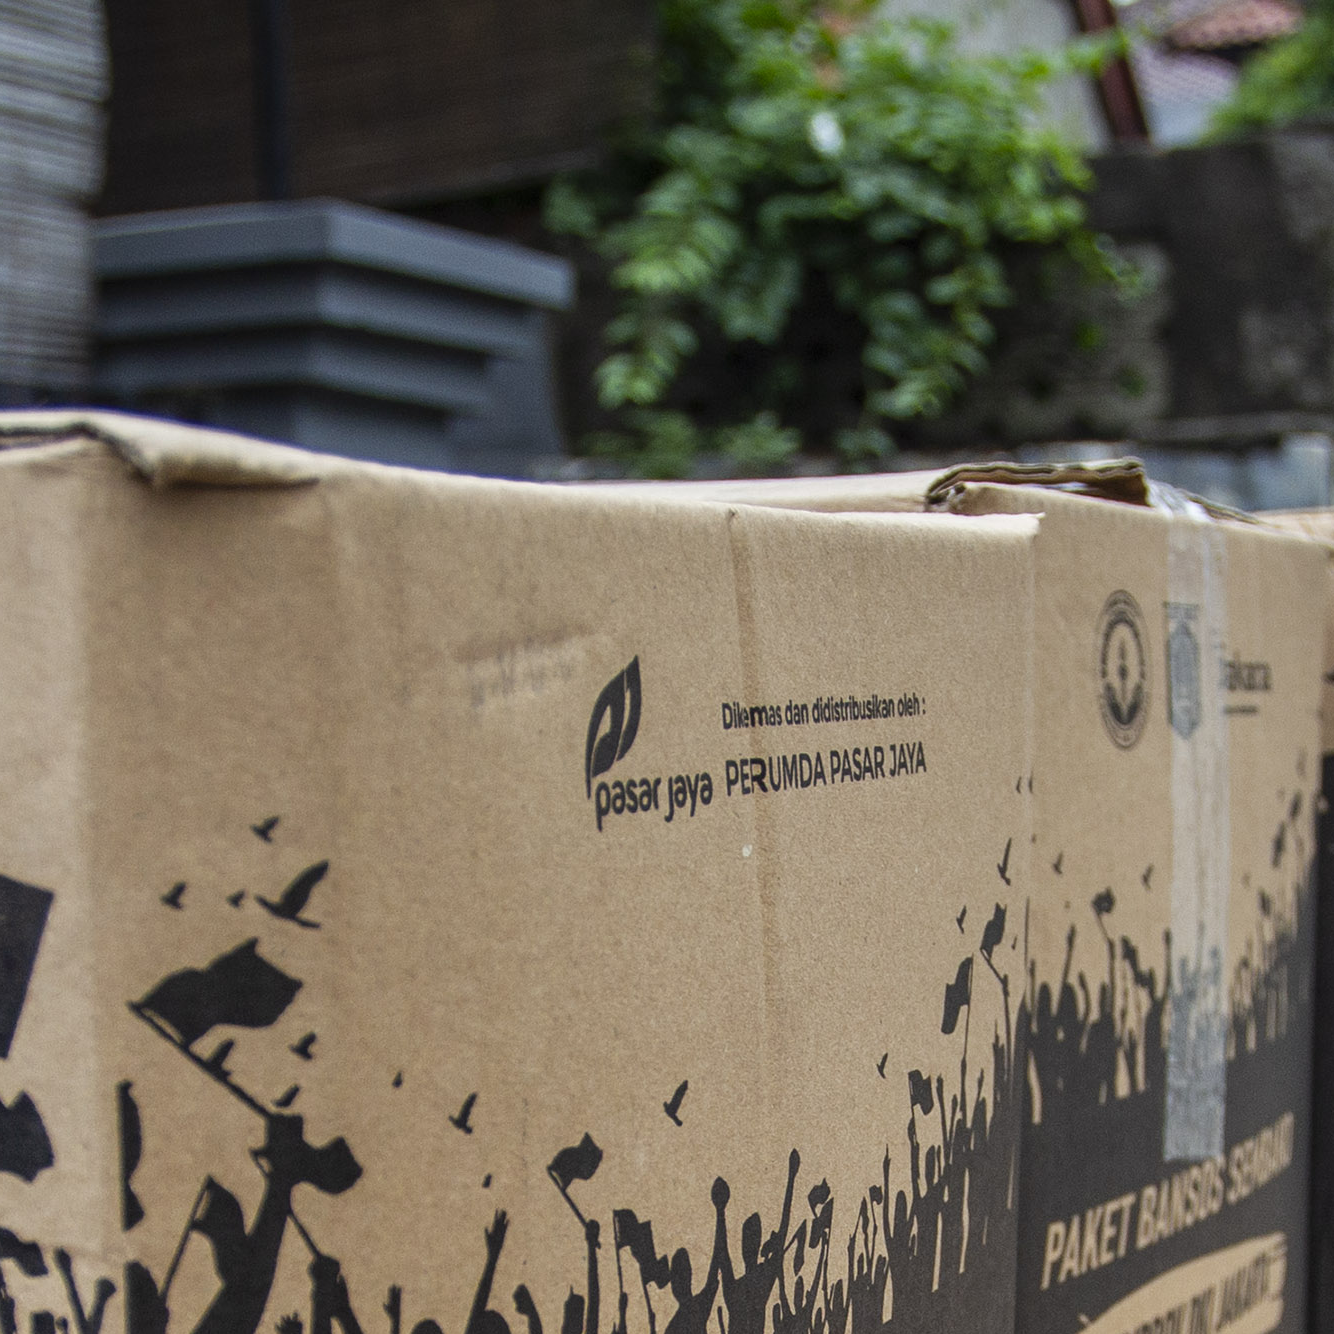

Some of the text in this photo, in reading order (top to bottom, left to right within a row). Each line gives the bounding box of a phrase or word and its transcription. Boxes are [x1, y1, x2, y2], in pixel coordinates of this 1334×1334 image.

[721, 702, 782, 730] Dikemas
[785, 699, 809, 726] dan
[811, 695, 895, 723] didistribusikan
[897, 693, 920, 718] oleh
[725, 741, 927, 797] PERUMDA PASAR JAYA
[595, 771, 713, 832] pasar jaya
[1040, 1193, 1136, 1291] PAKET
[1136, 1154, 1227, 1249] BANSOS
